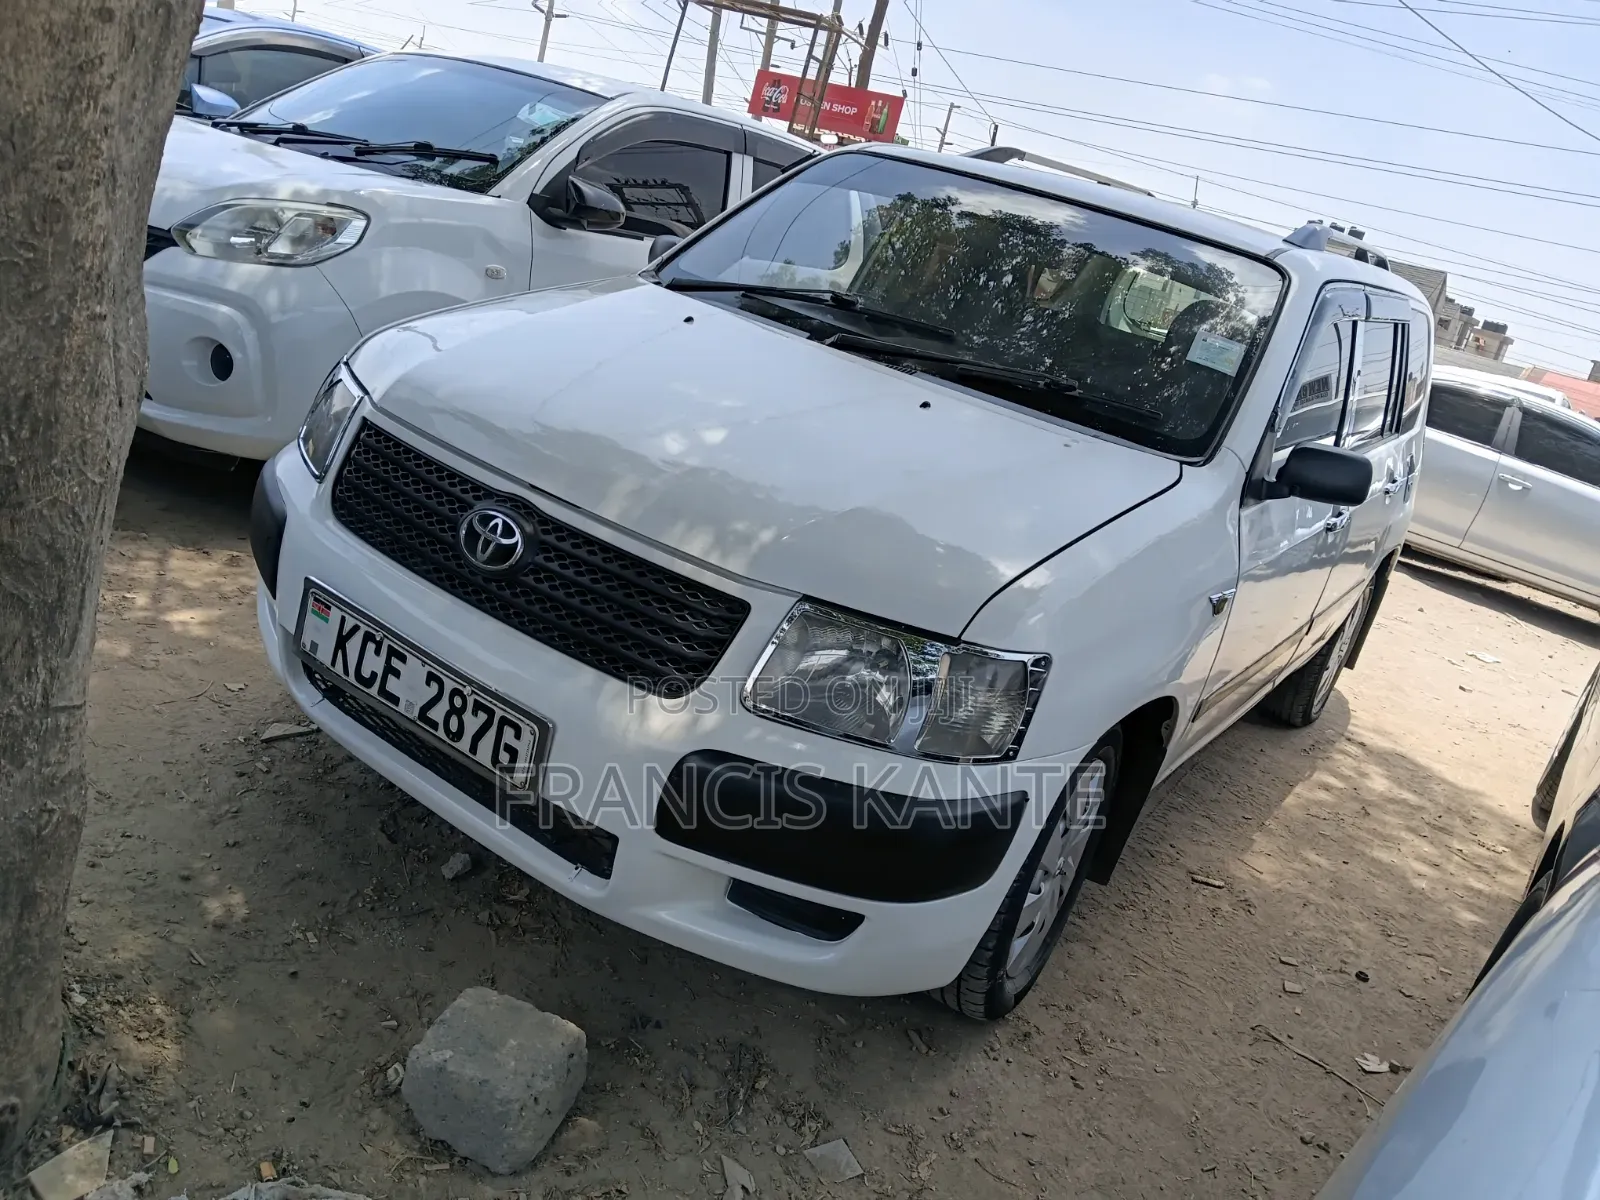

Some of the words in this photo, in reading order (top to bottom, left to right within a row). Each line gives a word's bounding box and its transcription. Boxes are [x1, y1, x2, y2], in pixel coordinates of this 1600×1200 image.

[832, 103, 857, 115] SHOP
[330, 614, 408, 707] KCE
[417, 670, 523, 780] 287G
